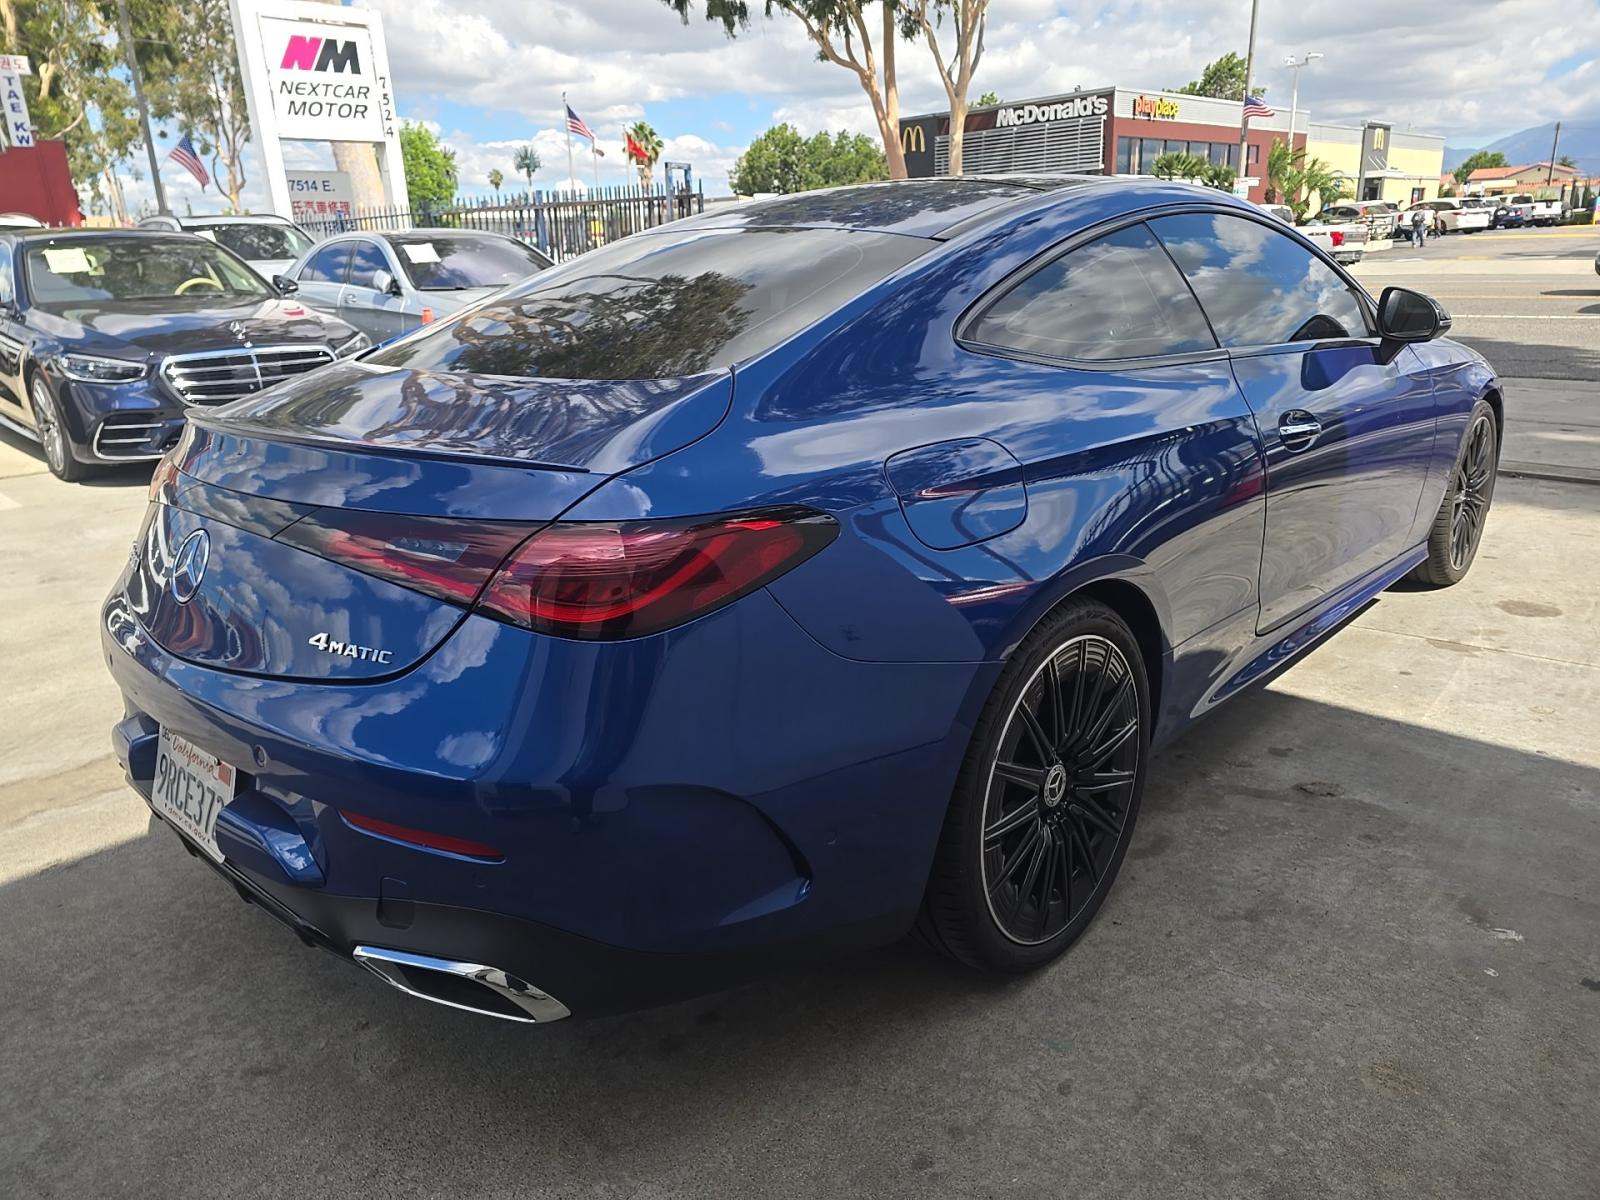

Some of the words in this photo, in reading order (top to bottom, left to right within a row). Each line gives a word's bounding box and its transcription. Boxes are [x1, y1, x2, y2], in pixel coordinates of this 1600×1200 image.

[280, 80, 370, 99] NEXTCAR
[288, 100, 368, 119] MOTOR
[378, 76, 394, 138] 7524
[996, 94, 1108, 128] McDonald's
[288, 179, 318, 191] 7514
[308, 632, 393, 665] 4MATIC
